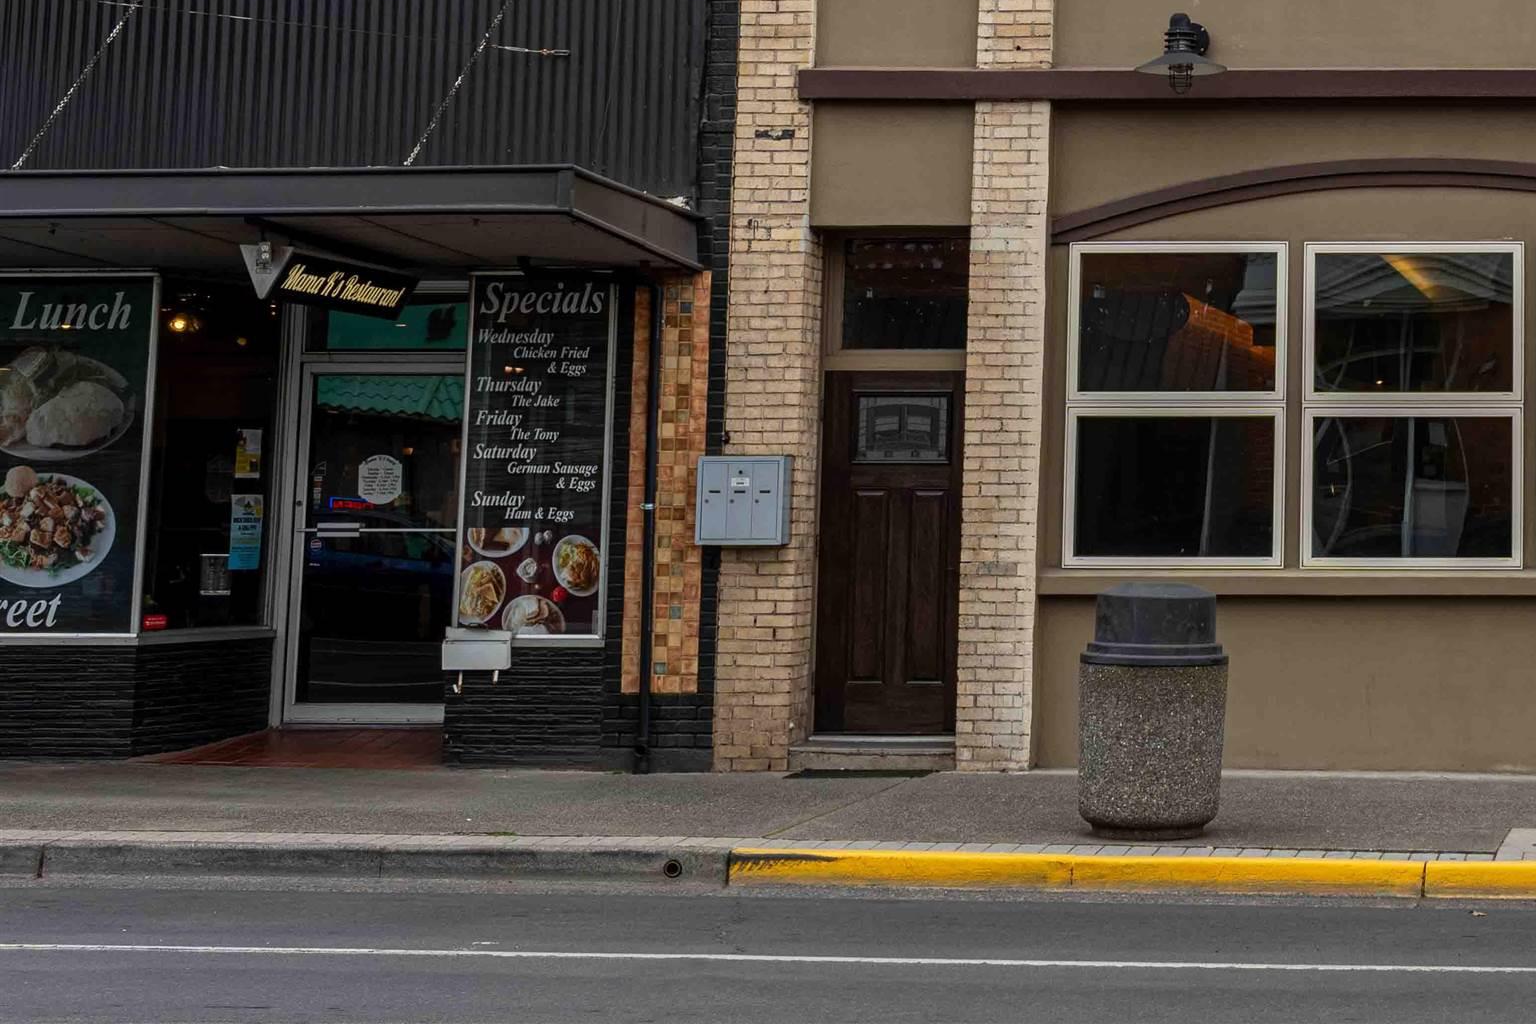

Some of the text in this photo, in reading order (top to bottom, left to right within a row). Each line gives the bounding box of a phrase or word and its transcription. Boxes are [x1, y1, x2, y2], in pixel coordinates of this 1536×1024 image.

[281, 264, 326, 294] Mama
[340, 275, 406, 308] Restaurant
[9, 291, 132, 330] Lunch
[480, 282, 605, 323] Specials
[478, 328, 555, 347] Wednesday
[513, 346, 591, 359] Chicken Fried
[547, 361, 587, 377] & Eggs
[477, 376, 542, 395] Thursday
[511, 395, 560, 407] The Jake
[475, 410, 523, 430] Friday
[510, 428, 560, 443] The Tony
[473, 443, 537, 463] Saturday
[507, 462, 599, 477] German Sausage
[556, 477, 597, 492] & Eggs
[472, 491, 526, 510] Sunday
[505, 507, 575, 523] Ham & Eggs
